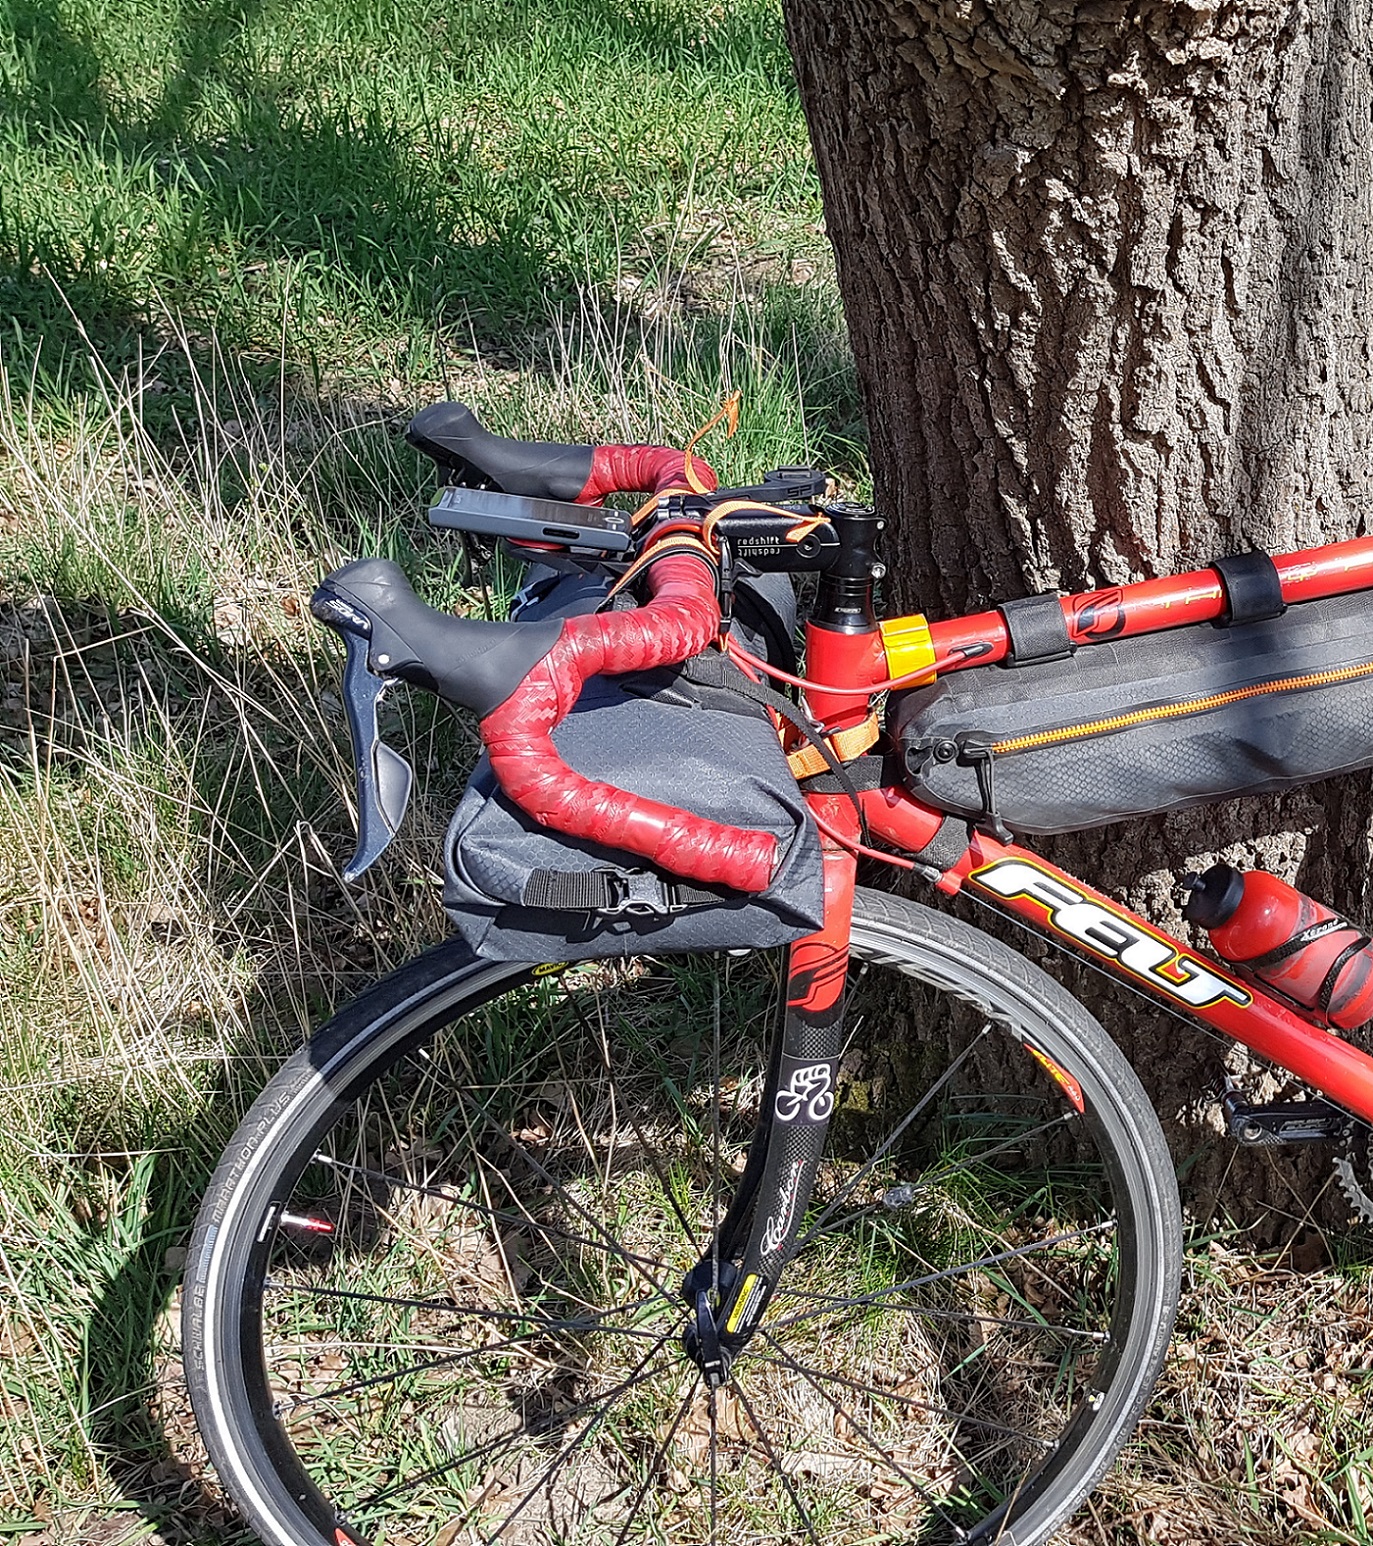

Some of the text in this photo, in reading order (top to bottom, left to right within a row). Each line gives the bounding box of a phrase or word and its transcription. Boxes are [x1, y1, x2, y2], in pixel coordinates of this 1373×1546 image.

[737, 536, 780, 545] redshift
[972, 861, 1251, 1006] FELT
[760, 1160, 806, 1255] Carbon
[191, 1282, 206, 1371] SCHWALBE
